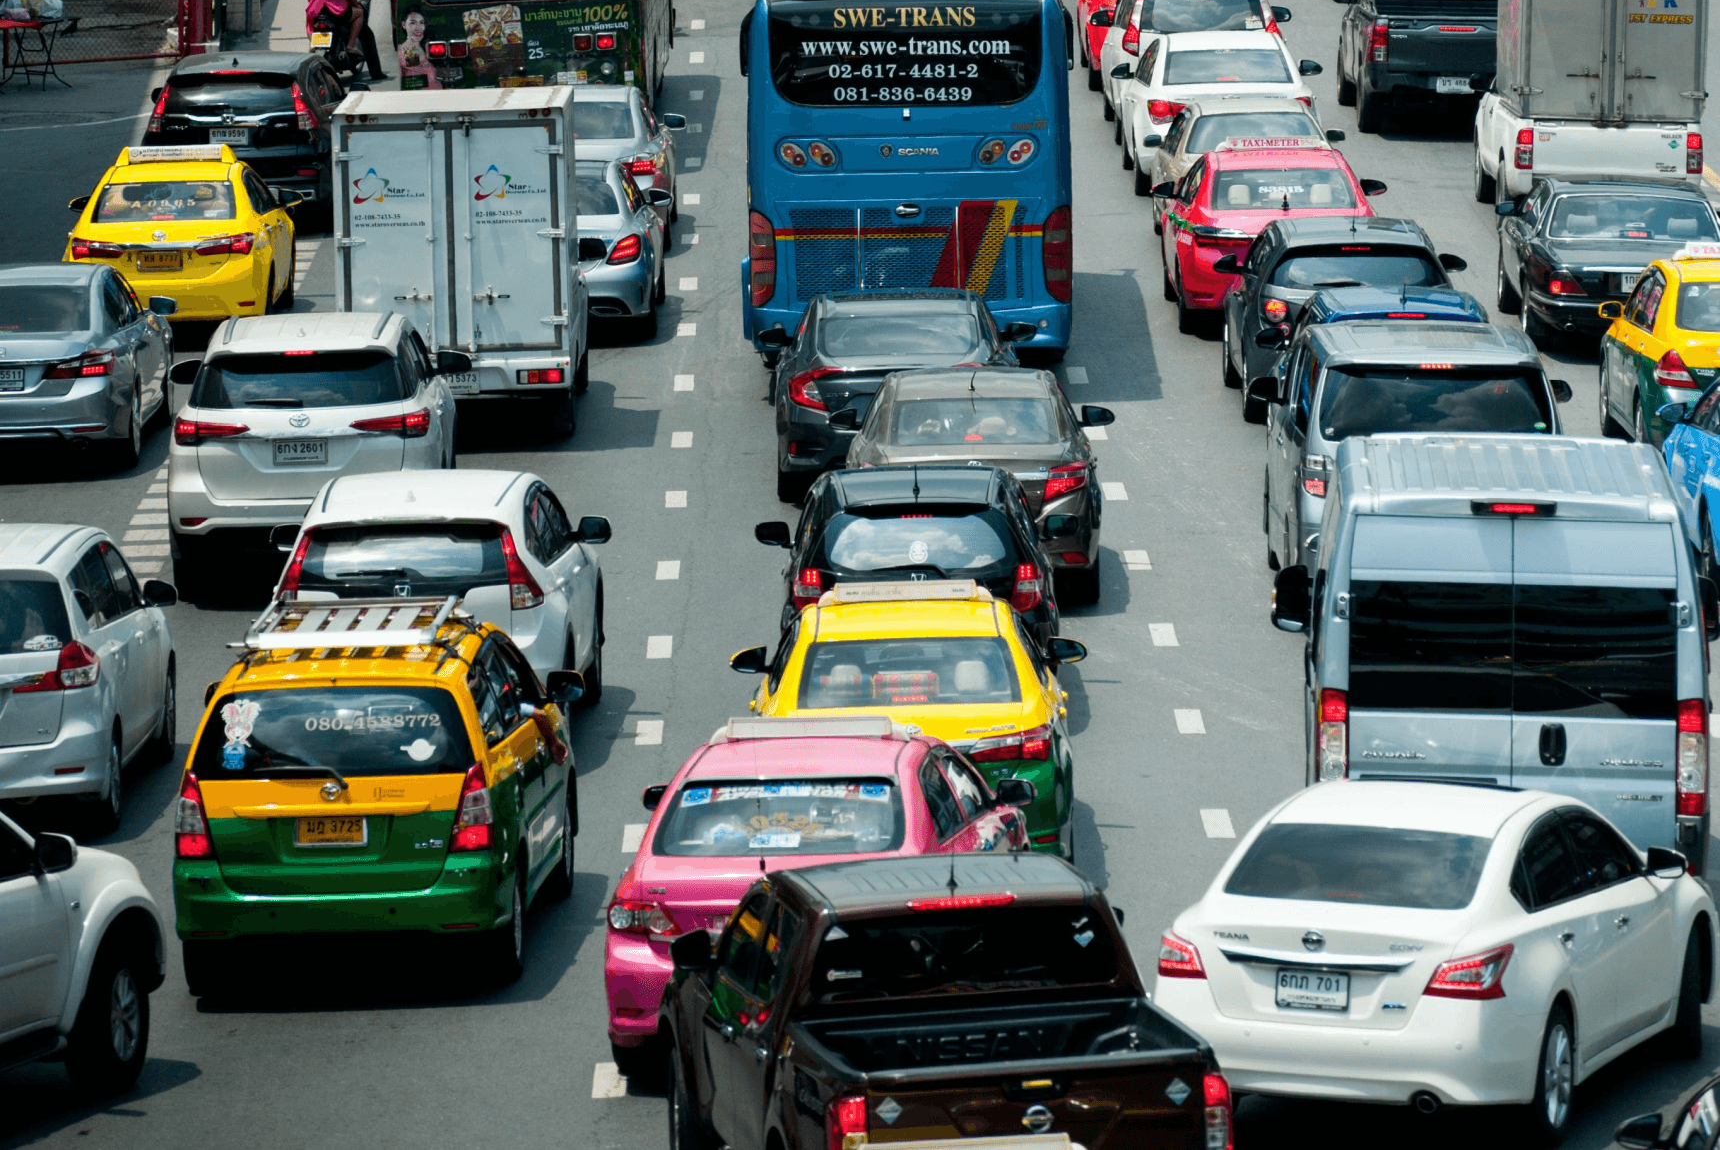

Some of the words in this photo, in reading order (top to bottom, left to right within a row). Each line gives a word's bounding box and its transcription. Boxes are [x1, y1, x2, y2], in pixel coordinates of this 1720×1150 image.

[583, 4, 629, 23] 100%
[833, 6, 976, 29] SWE-TRANS
[1629, 13, 1648, 23] TST
[1649, 13, 1694, 25] EXPRESS
[801, 36, 1011, 56] www.swe-trans.com
[828, 63, 979, 78] 02-617-4481-2
[833, 87, 972, 101] 081-836-6439
[1241, 139, 1300, 147] TAXI-METER
[897, 147, 940, 156] SCANIA
[354, 220, 426, 228] www.staroverseas.co.th
[475, 217, 548, 225] www.staroverseas.co.th
[455, 373, 477, 383] 5373
[300, 442, 324, 454] 2601
[1600, 758, 1663, 768] JUMPER
[330, 819, 362, 834] 3725
[1213, 931, 1250, 940] TEANA
[1316, 977, 1341, 992] 701
